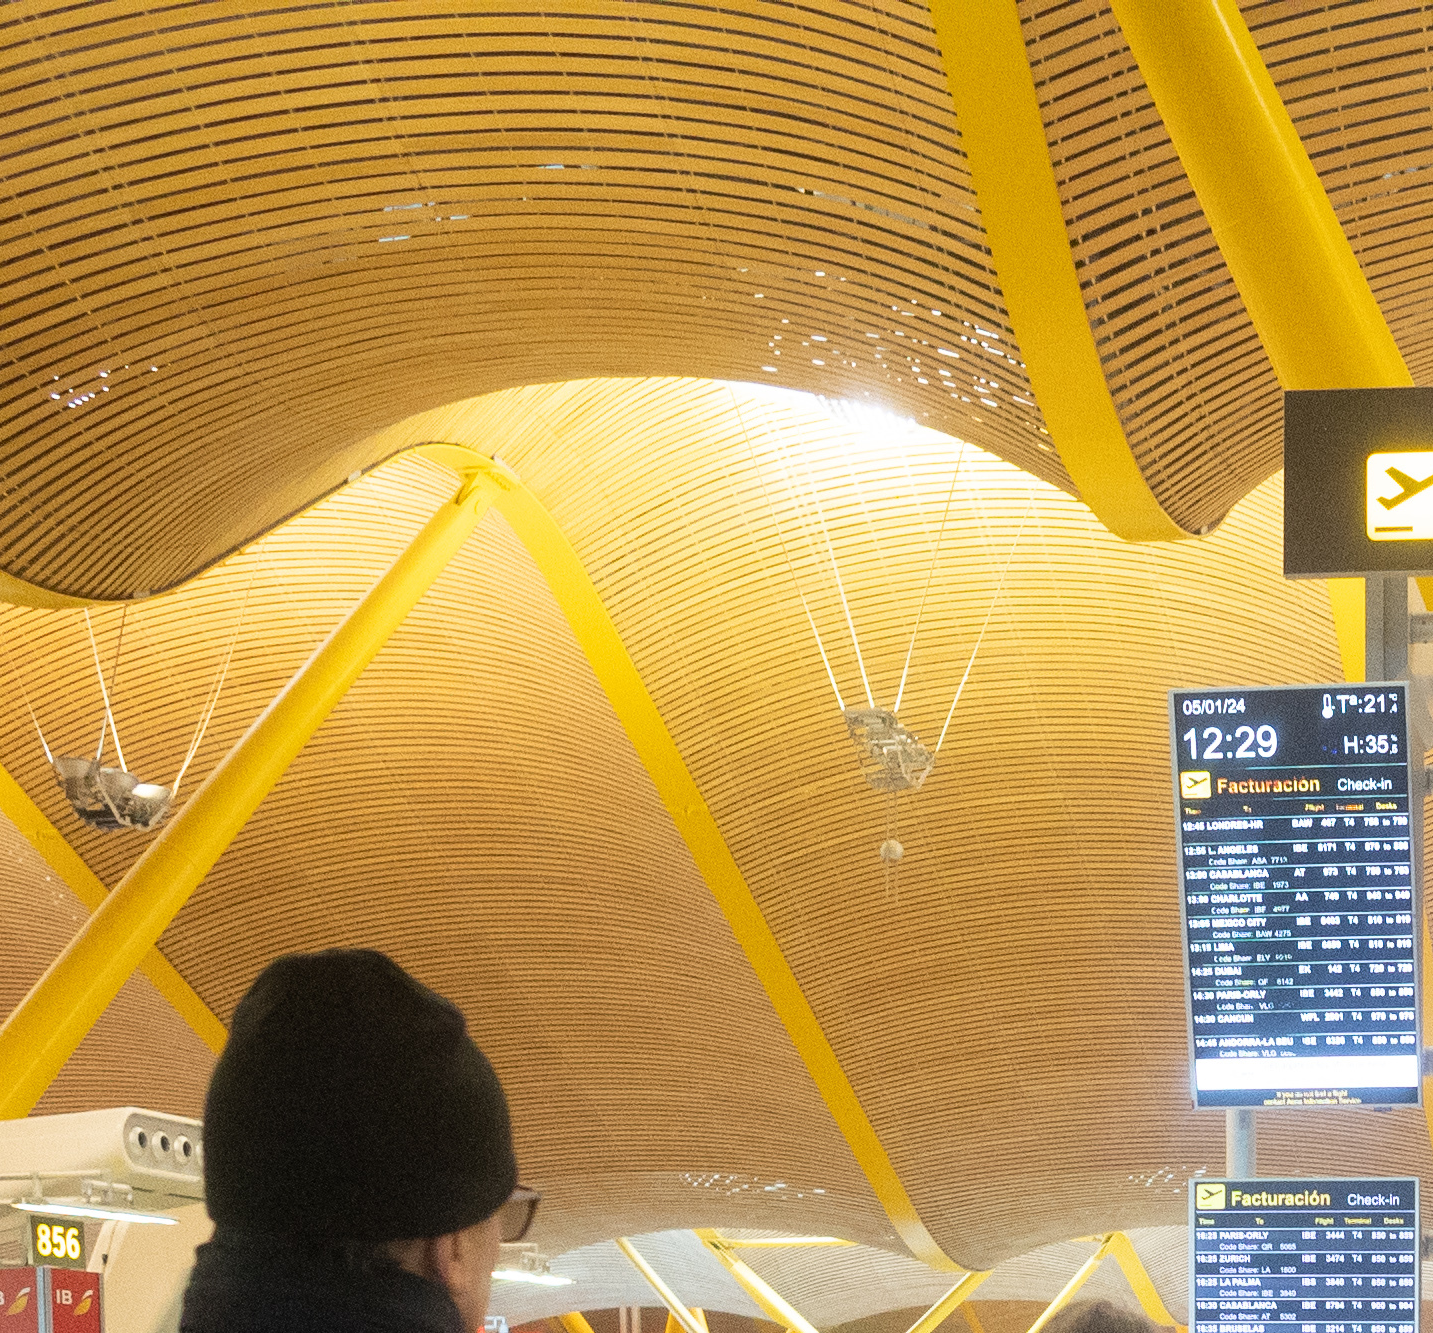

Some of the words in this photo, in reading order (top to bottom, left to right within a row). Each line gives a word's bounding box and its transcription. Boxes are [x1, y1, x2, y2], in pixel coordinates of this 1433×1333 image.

[1183, 698, 1245, 715] 05/01/24
[1183, 724, 1278, 759] 12:29
[1217, 777, 1320, 794] Facturación
[1338, 778, 1392, 791] Check-in
[1231, 1190, 1331, 1206] Facturación
[1347, 1193, 1400, 1206] Check-in
[36, 1223, 81, 1259] 856
[56, 1289, 72, 1305] IB
